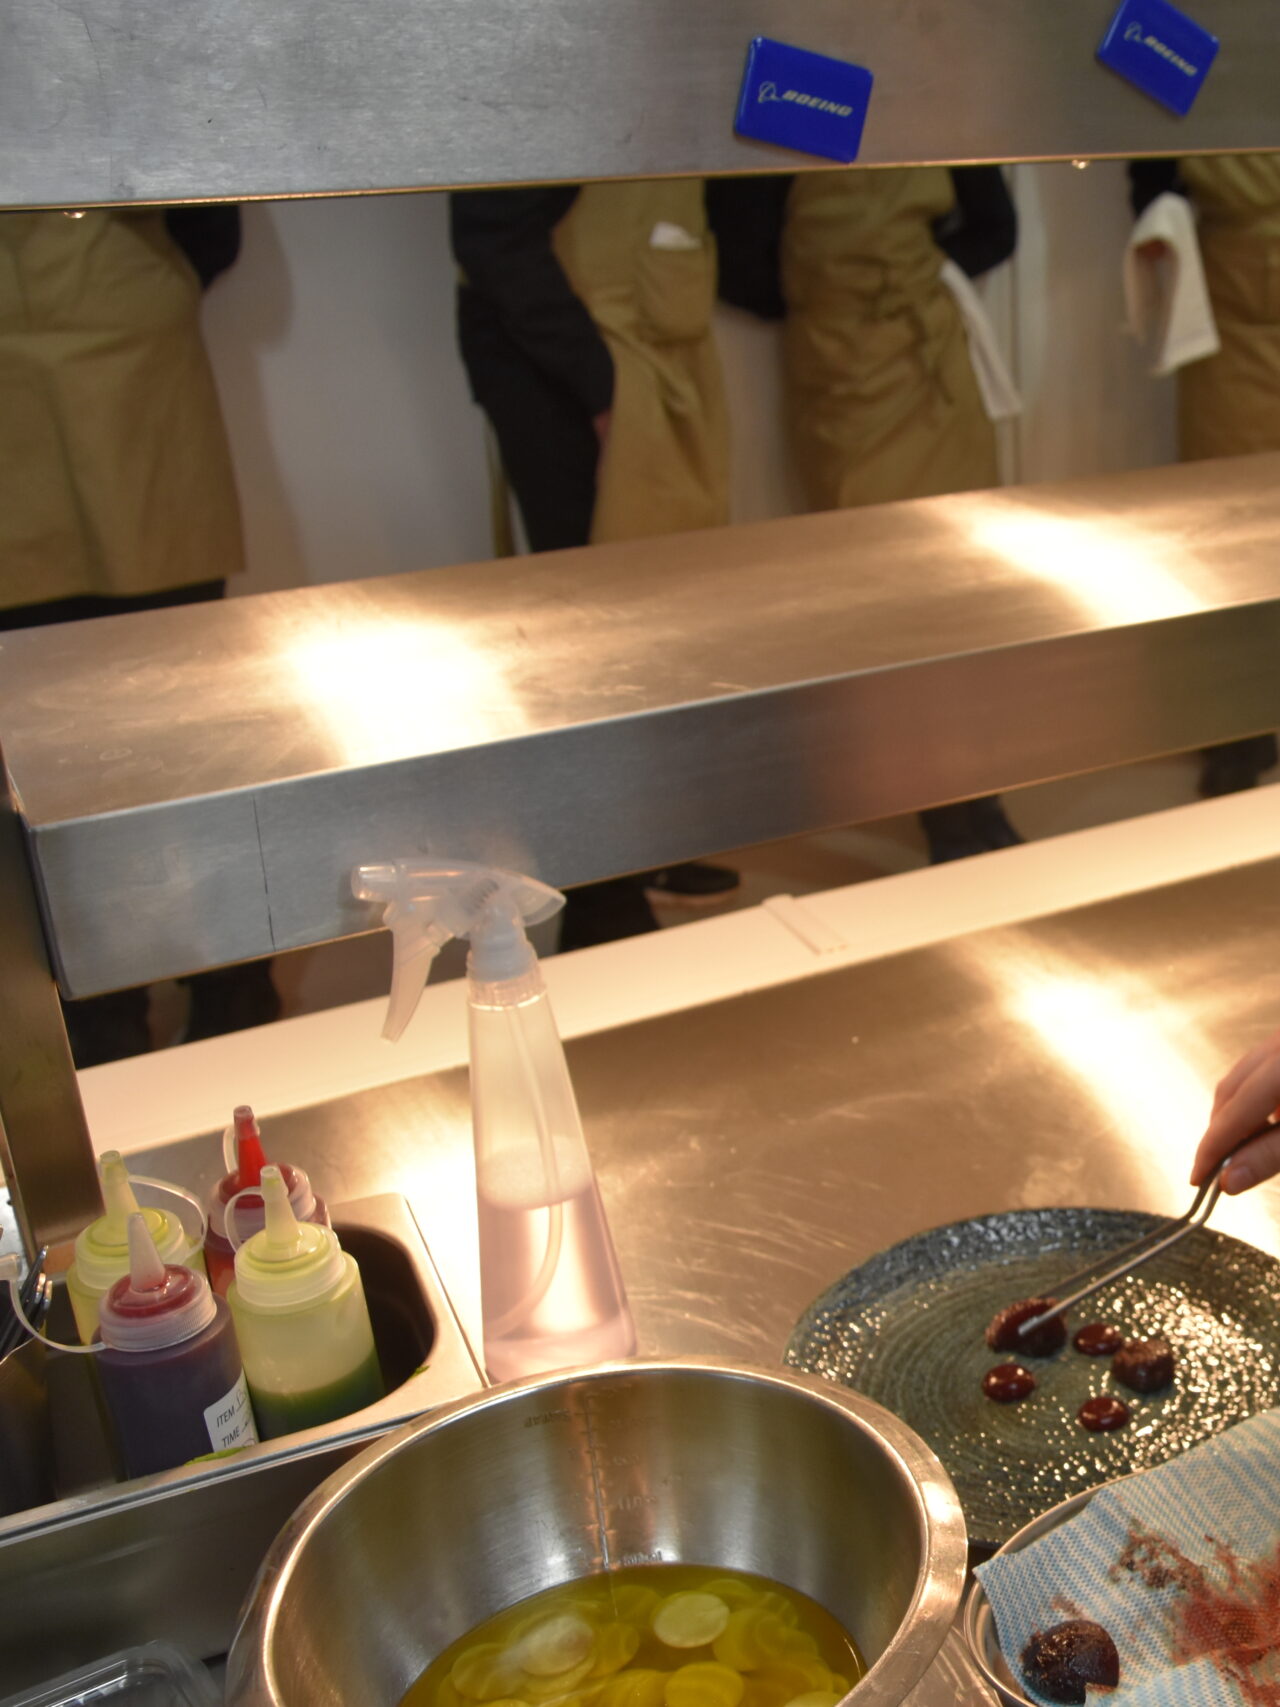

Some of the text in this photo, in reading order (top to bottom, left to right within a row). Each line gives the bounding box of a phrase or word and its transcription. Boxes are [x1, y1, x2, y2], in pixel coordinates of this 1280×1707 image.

[1143, 35, 1198, 76] BOEING
[782, 89, 853, 117] BOEING
[215, 1405, 236, 1428] ITEM
[222, 1426, 241, 1448] TIME
